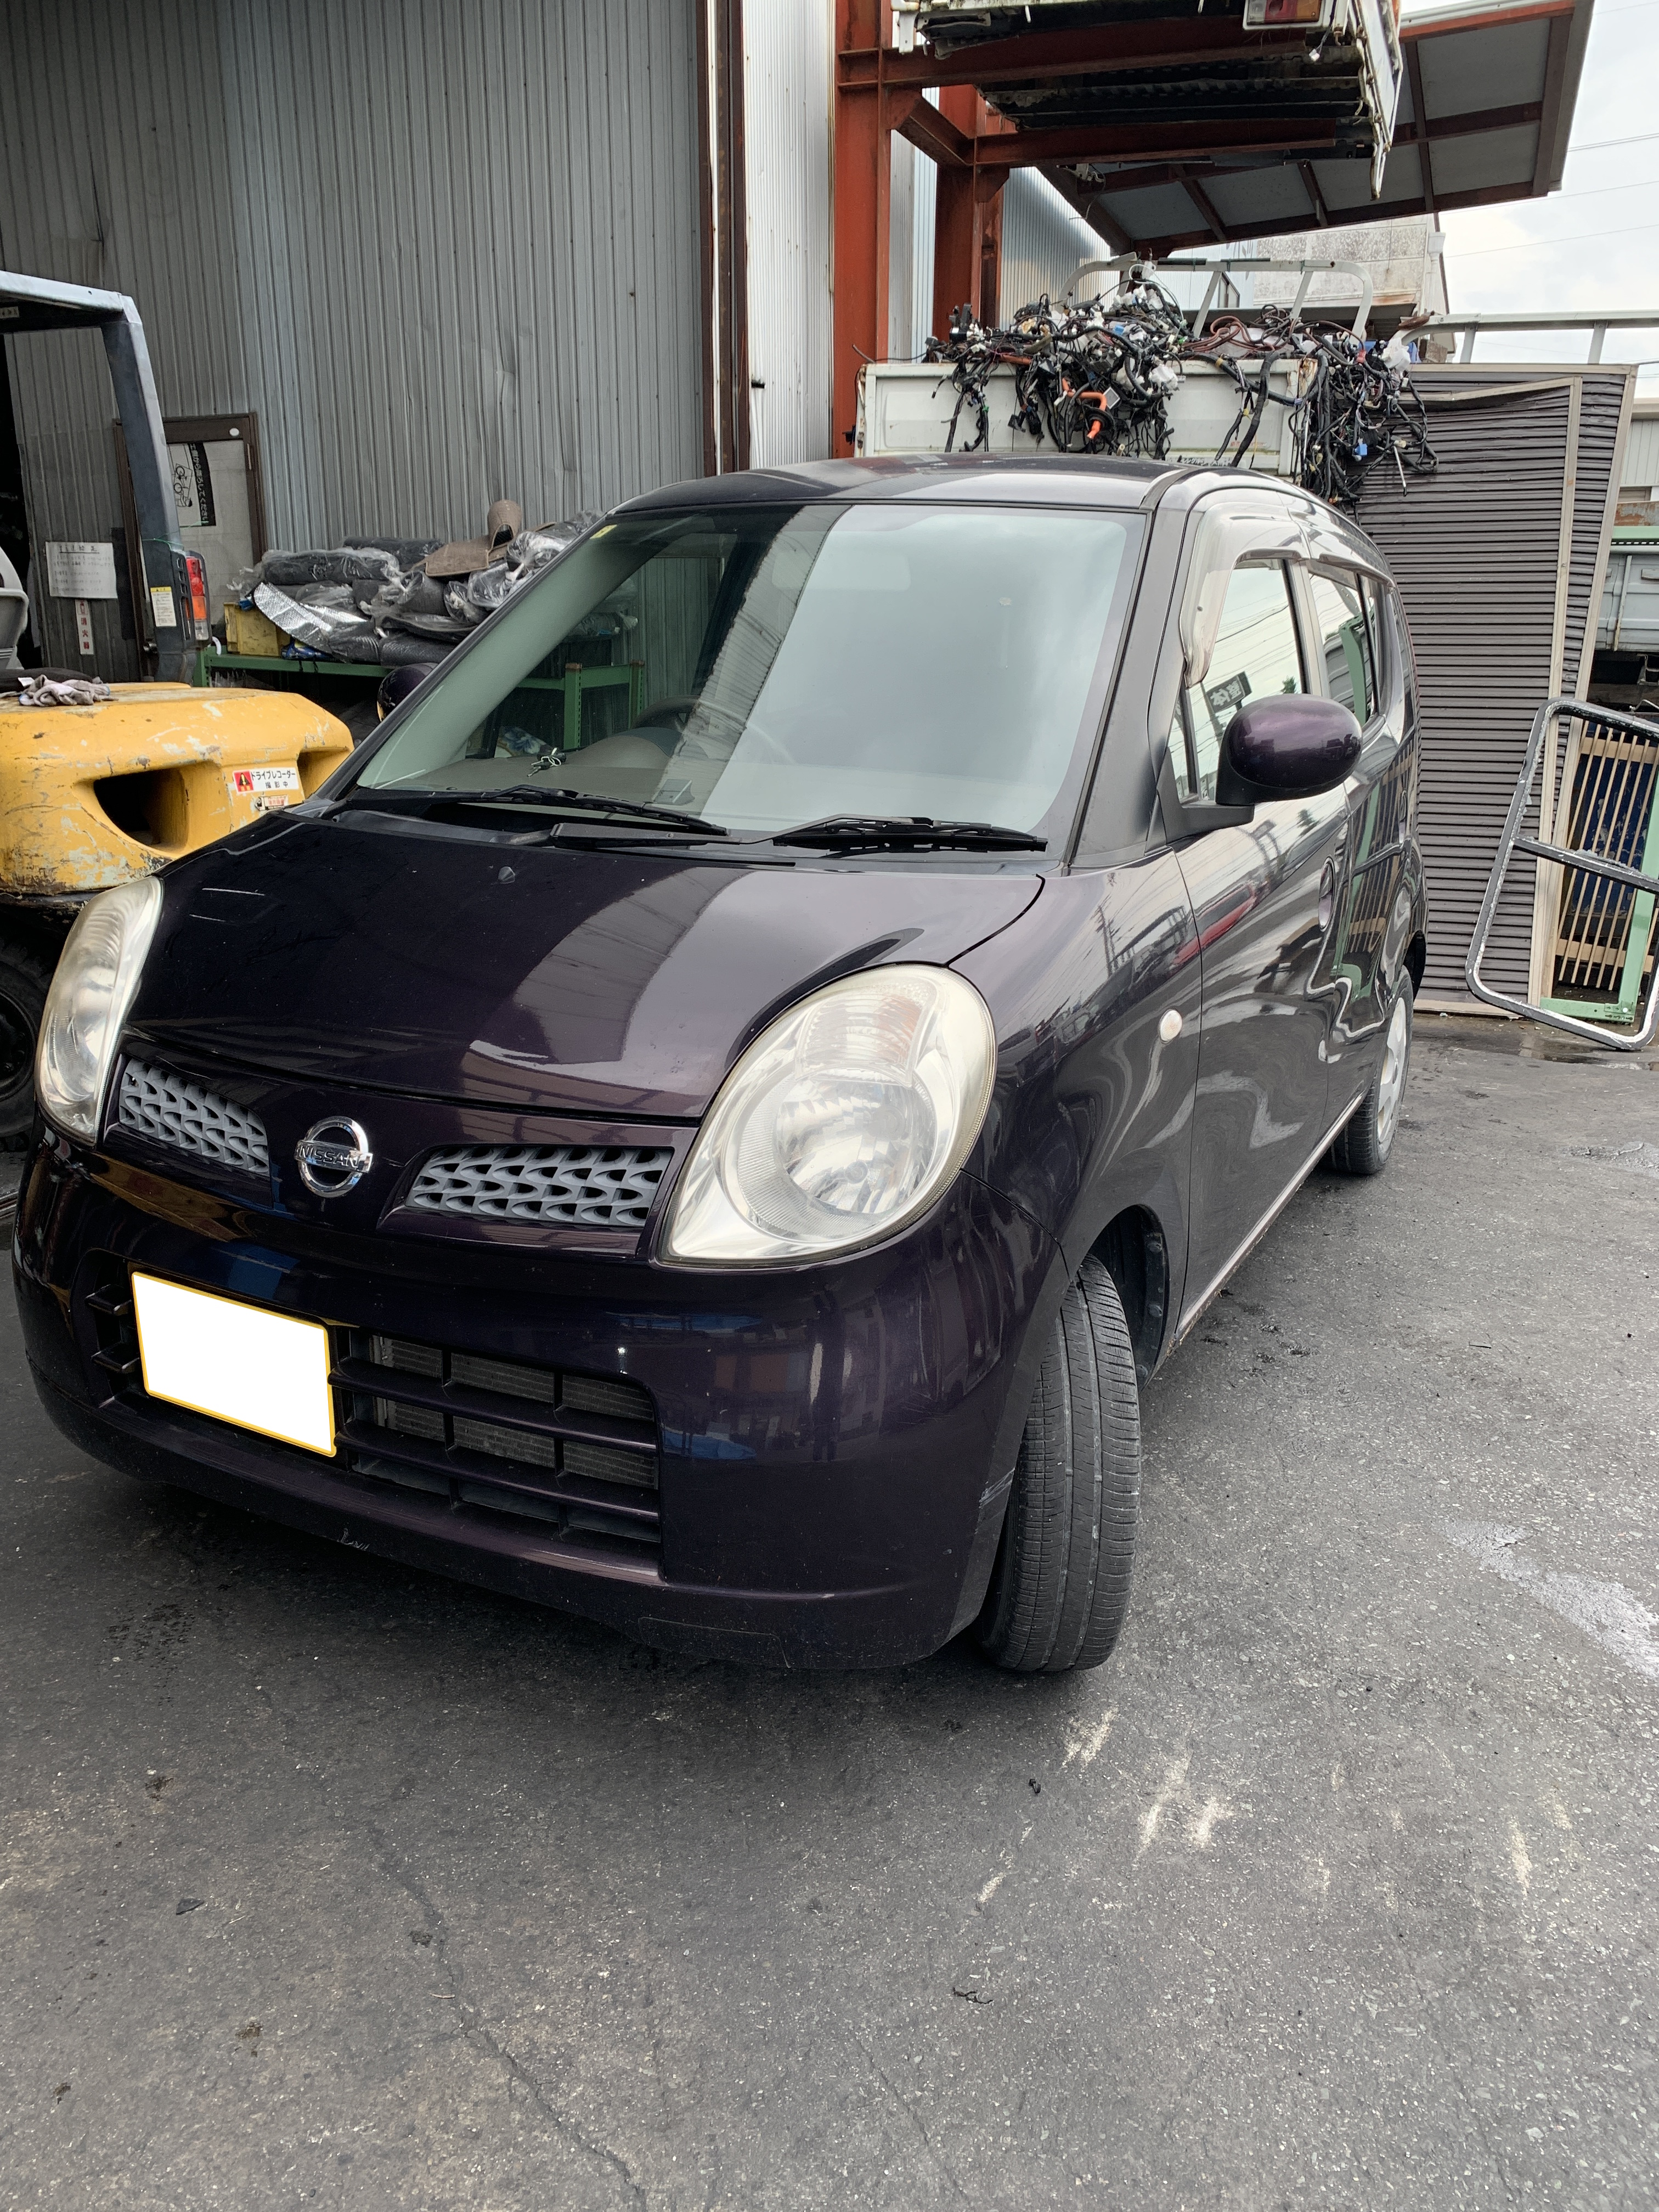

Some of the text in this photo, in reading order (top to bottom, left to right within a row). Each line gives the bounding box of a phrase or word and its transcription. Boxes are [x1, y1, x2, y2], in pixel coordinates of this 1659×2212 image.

[250, 770, 296, 781] ドライブレコーダー
[299, 1146, 361, 1169] NISSAN
